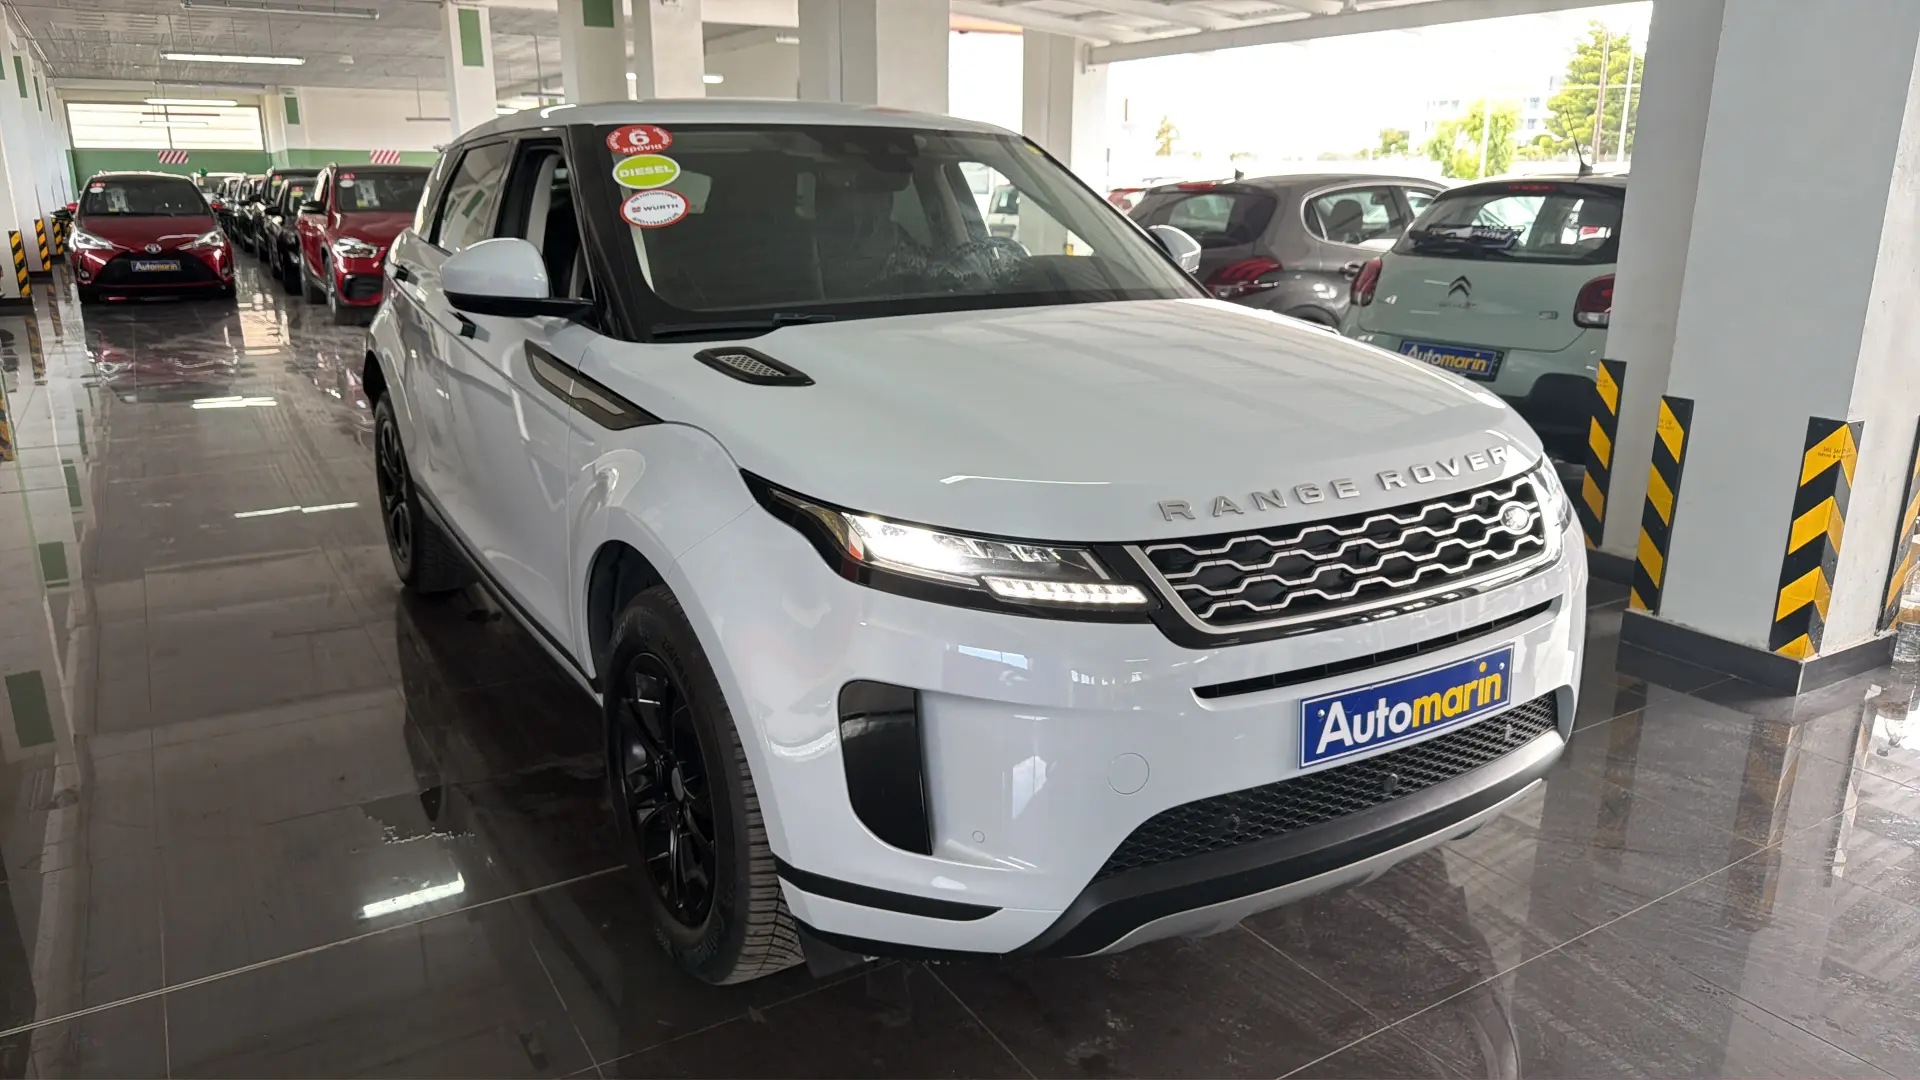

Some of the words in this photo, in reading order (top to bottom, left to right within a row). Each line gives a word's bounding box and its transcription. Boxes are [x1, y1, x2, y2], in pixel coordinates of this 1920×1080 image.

[619, 164, 674, 178] DIESEL
[1407, 344, 1487, 372] Automarin
[1157, 477, 1361, 522] RANGE
[1376, 445, 1509, 492] ROVER
[1316, 661, 1502, 754] Automarin
